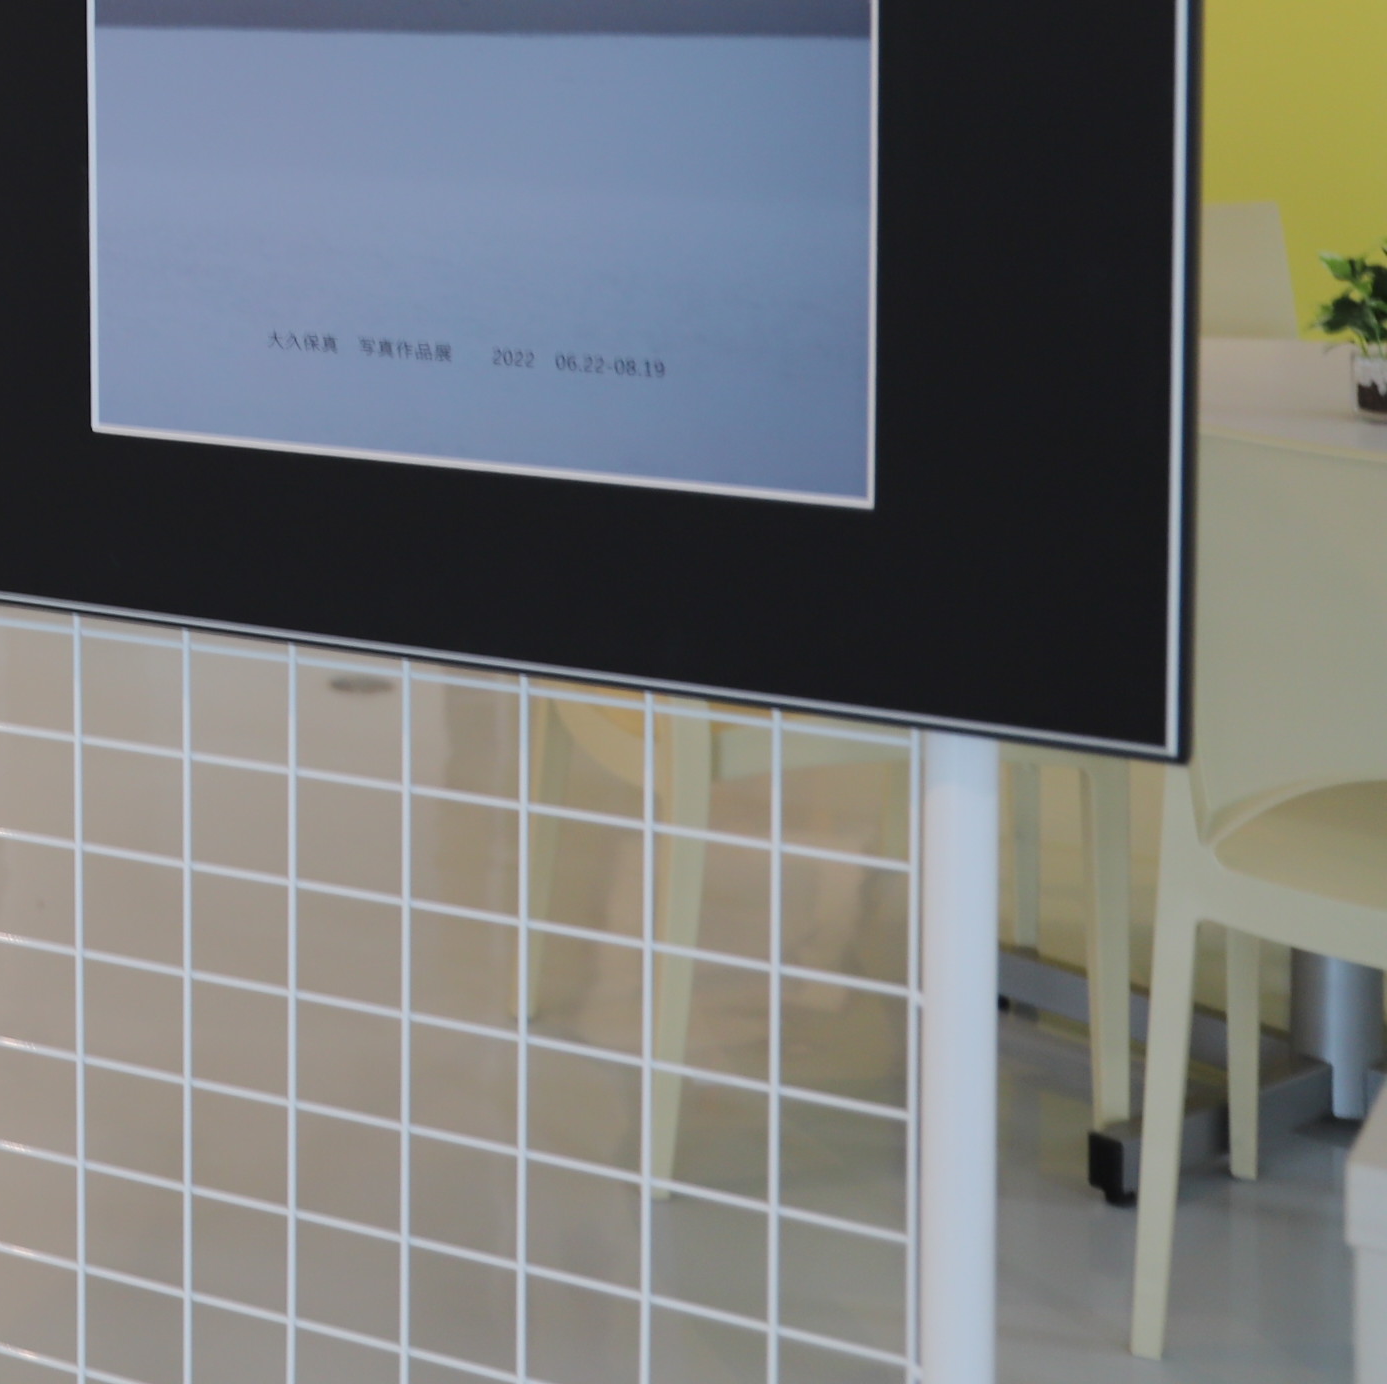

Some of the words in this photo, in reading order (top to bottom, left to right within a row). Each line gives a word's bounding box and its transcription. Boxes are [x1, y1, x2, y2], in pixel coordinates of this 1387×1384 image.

[358, 335, 453, 362] 写真作品展
[492, 346, 535, 368] 2022
[554, 350, 666, 379] 06.22-08.19
